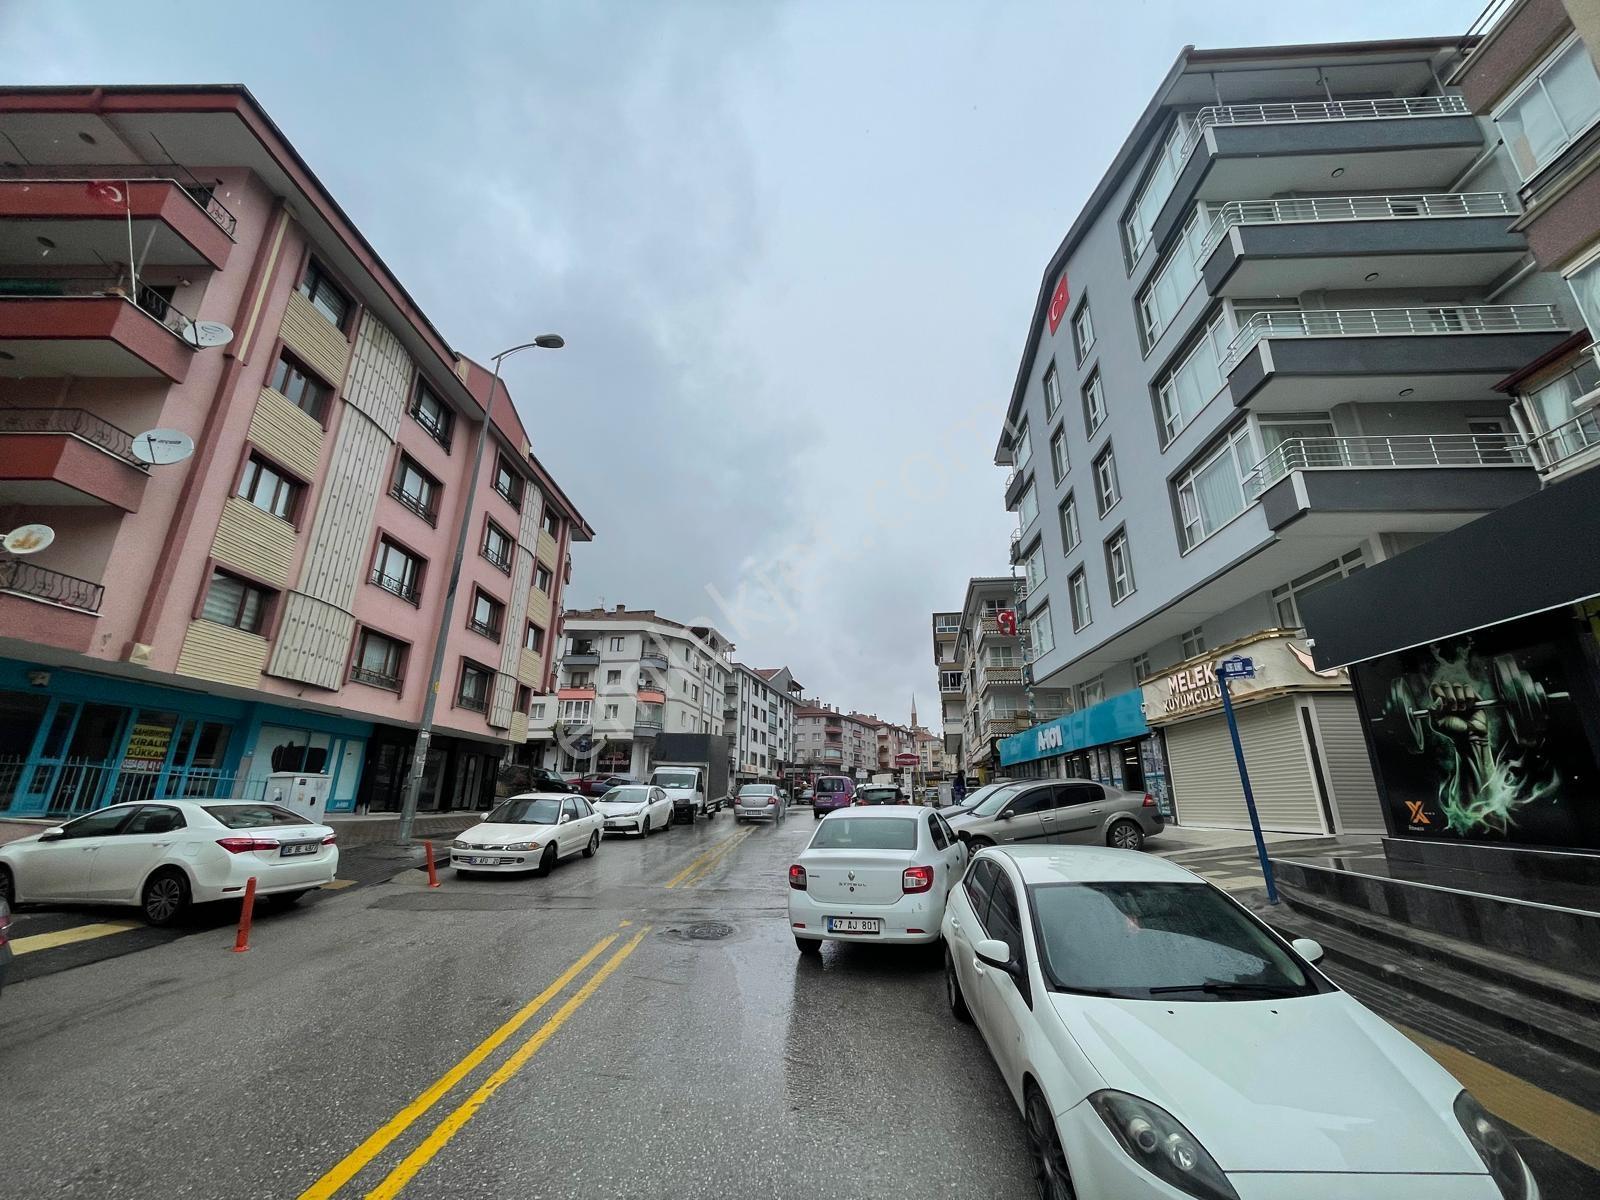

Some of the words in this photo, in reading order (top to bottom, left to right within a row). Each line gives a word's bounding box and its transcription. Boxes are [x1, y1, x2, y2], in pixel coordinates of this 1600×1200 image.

[1167, 662, 1217, 695] MELEK
[1164, 681, 1231, 712] KUYUMCULU
[130, 737, 168, 748] KİRALIK
[127, 746, 165, 758] DÜKKAN
[833, 920, 843, 929] 47
[847, 921, 858, 930] AJ
[862, 921, 877, 931] 801
